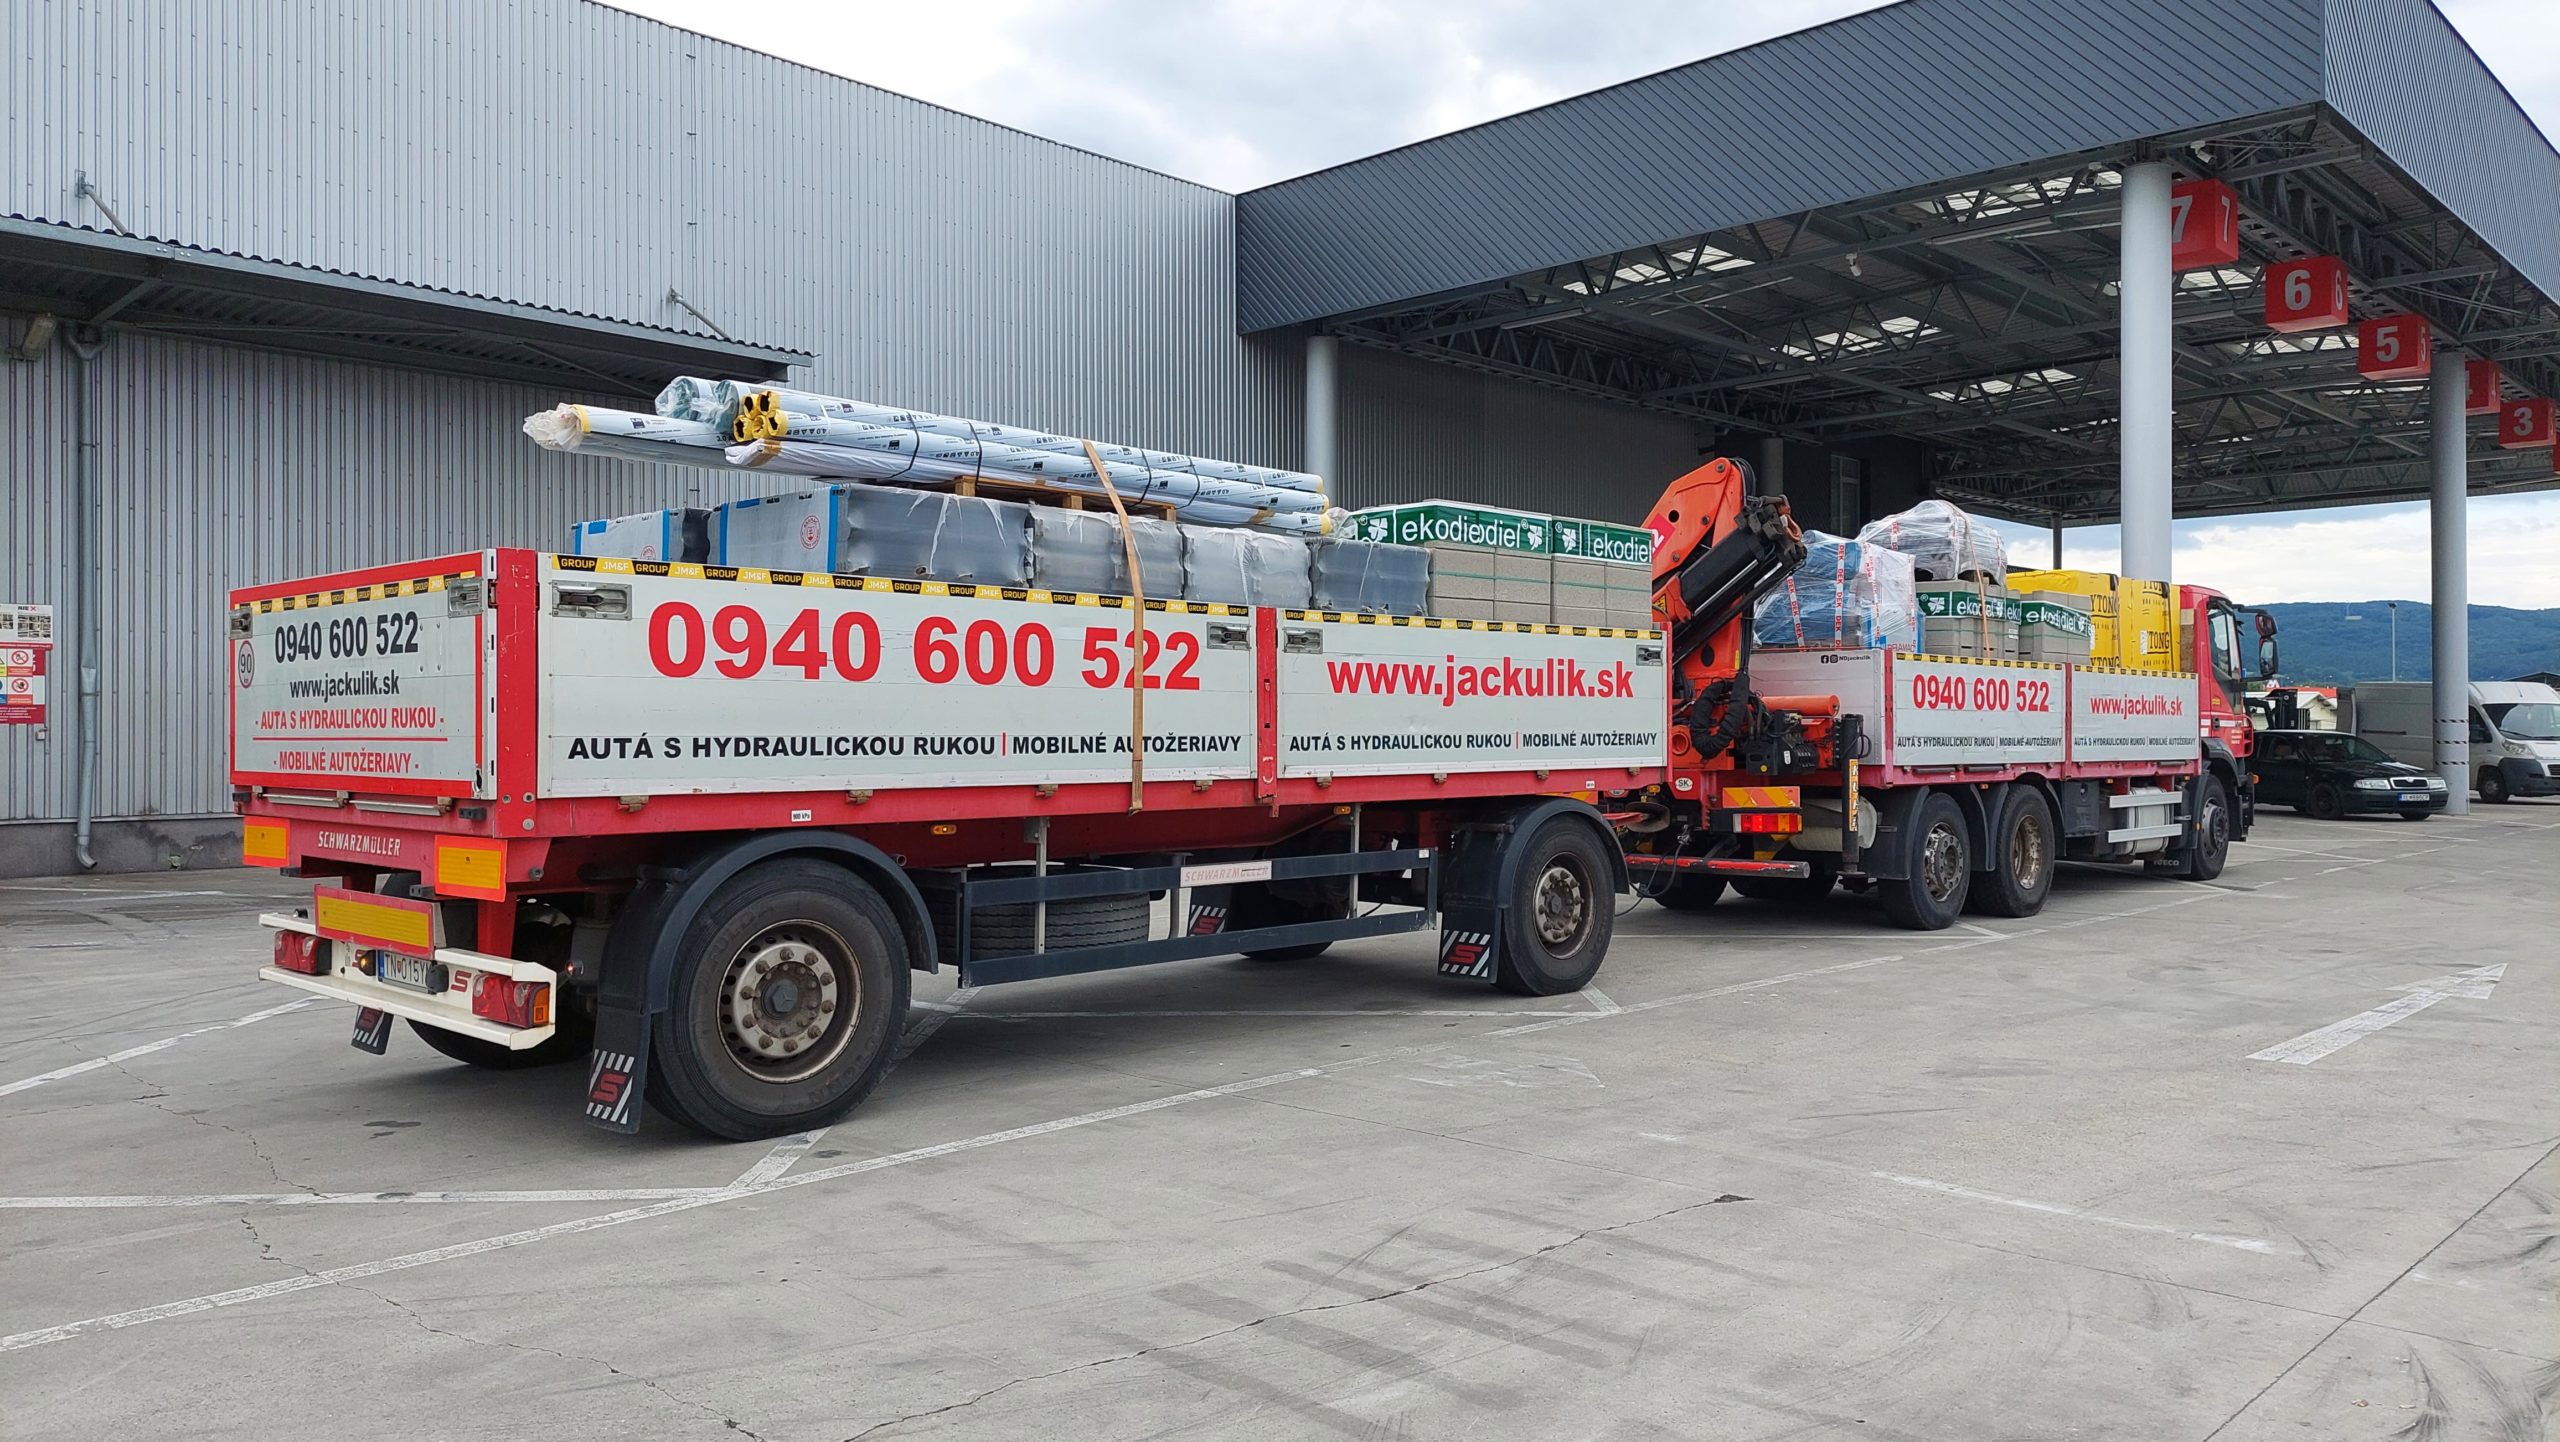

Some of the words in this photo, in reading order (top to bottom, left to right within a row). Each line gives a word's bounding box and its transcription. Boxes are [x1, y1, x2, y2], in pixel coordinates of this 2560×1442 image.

[2171, 195, 2193, 243] 7
[2221, 195, 2231, 243] 7
[2284, 270, 2312, 311] 6
[2335, 270, 2343, 310] 6
[2376, 326, 2400, 362] 5
[2513, 407, 2533, 436] 3
[561, 558, 596, 569] GROUP
[602, 560, 629, 571] JM&F
[635, 563, 669, 574] GROUP
[674, 566, 700, 577] JM&F
[706, 568, 737, 579] GROUP
[742, 571, 767, 581] JM&F
[772, 573, 802, 584] GROUP
[807, 576, 831, 586] JM&F
[835, 578, 863, 588] GROUP
[868, 581, 889, 590] JM&F
[894, 581, 921, 593] GROUP
[950, 585, 975, 596] GROUP
[1002, 590, 1027, 600] GROUP
[1053, 594, 1076, 603] GROUP
[1100, 597, 1122, 606] GROUP
[1145, 600, 1167, 609] GROUP
[1188, 603, 1208, 613] GROUP
[1229, 606, 1248, 615] GROUP
[1787, 579, 1795, 593] DEK
[1791, 601, 1799, 617] DEK
[275, 621, 322, 663] 0940
[329, 616, 369, 658] 600
[376, 611, 419, 655] 522
[1795, 623, 1803, 639] DEK
[2147, 631, 2170, 649] TONG
[648, 601, 881, 682] 0940
[913, 616, 1054, 687] 600
[1080, 626, 1200, 690] 522
[241, 653, 252, 673] 90
[290, 669, 400, 703] www.jackulik.sk
[1327, 654, 1634, 707] www.jackulik.sk
[1913, 674, 1966, 711] 0940
[1973, 677, 2010, 711] 600
[2016, 680, 2050, 712] 522
[261, 711, 287, 730] AUTA
[289, 712, 296, 727] S
[300, 708, 387, 729] HYDRAULICKOU
[391, 707, 436, 729] RUKOU
[2090, 693, 2183, 720] www.jackulik.sk
[568, 732, 654, 760] AUTÁ
[664, 737, 682, 759] S
[692, 736, 905, 758] HYDRAULICKOU
[913, 736, 996, 756] RUKOU
[1012, 732, 1107, 754] MOBILNÉ
[1113, 732, 1242, 754] AUTOŽERIAVY
[1290, 732, 1332, 752] AUTÁ
[1336, 736, 1346, 751] S
[1351, 735, 1462, 751] HYDRAULICKOU
[1466, 734, 1512, 750] RUKOU
[1522, 730, 1577, 748] MOBILNÉ
[1579, 730, 1658, 747] AUTOŽERIAVY
[1917, 737, 1922, 748] S
[1923, 736, 1973, 748] HYDRAULICKOU
[1973, 736, 1996, 748] RUKOU
[279, 747, 326, 770] MOBILNÉ
[329, 747, 411, 774] AUTOŽERIAVY
[1678, 779, 1689, 787] SK
[318, 830, 401, 856] SCHWARZMÜLLER
[385, 954, 397, 978] TN
